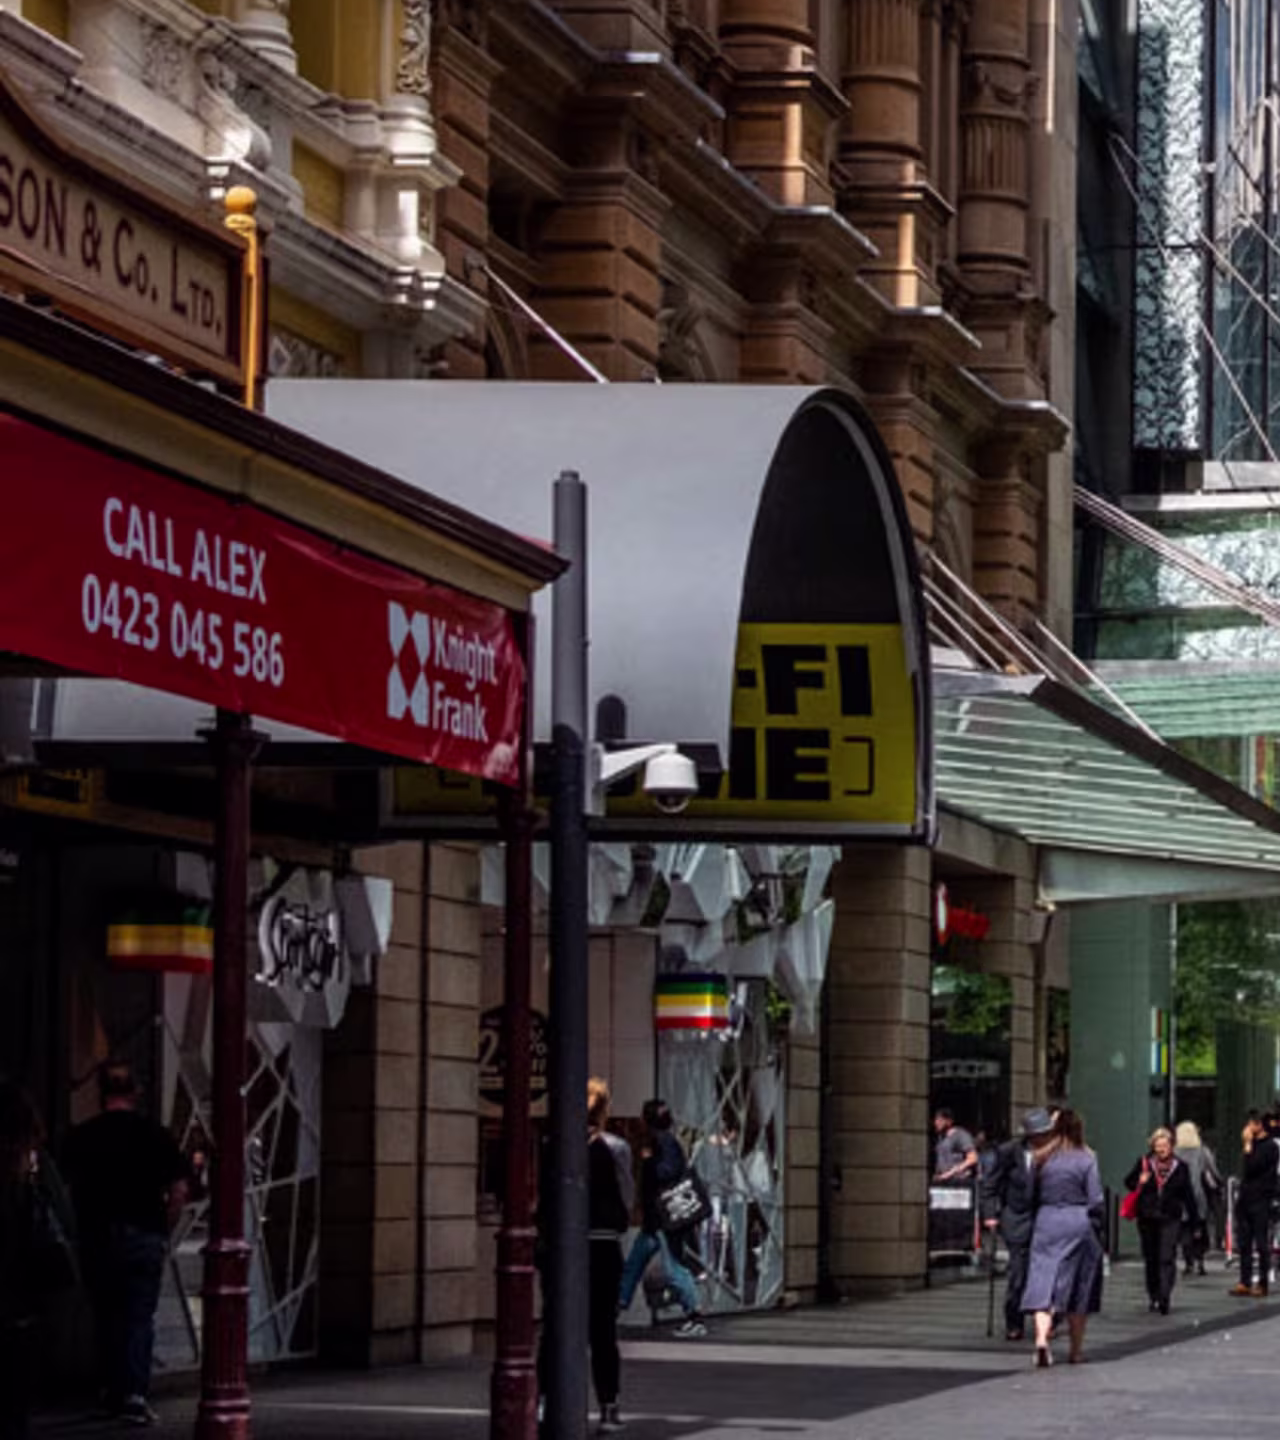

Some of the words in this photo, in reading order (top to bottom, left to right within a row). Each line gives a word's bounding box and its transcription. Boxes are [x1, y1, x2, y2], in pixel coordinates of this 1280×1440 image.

[81, 201, 101, 273] &
[103, 497, 182, 578] CALL
[190, 529, 267, 606] ALEX
[81, 573, 160, 652] 0423
[169, 600, 224, 671] 045
[233, 621, 285, 688] 586
[433, 617, 499, 690] Knight
[432, 681, 489, 743] Frank
